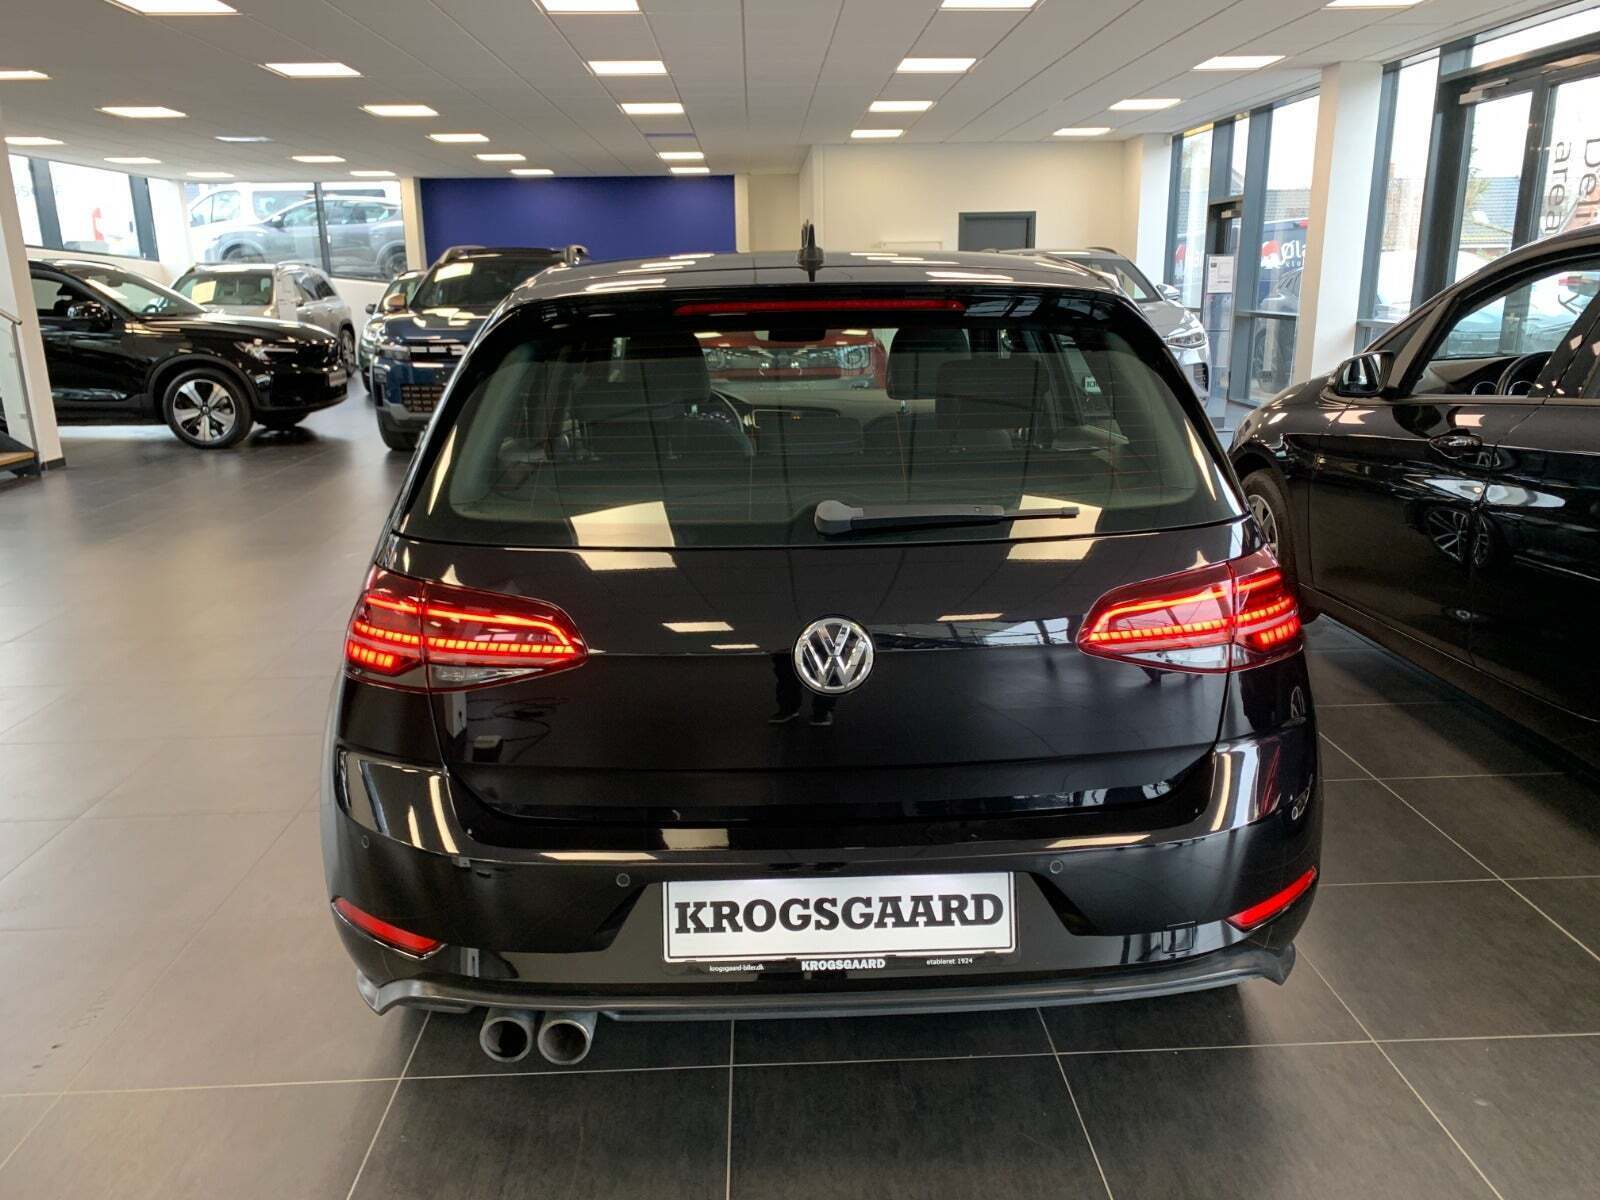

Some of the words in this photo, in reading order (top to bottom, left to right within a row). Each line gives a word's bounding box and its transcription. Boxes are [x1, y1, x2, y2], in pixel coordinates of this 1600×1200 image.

[1545, 141, 1571, 231] area
[675, 893, 1004, 934] KROGSGAARD
[801, 958, 886, 972] KROGSGAARD
[958, 957, 973, 965] 1924
